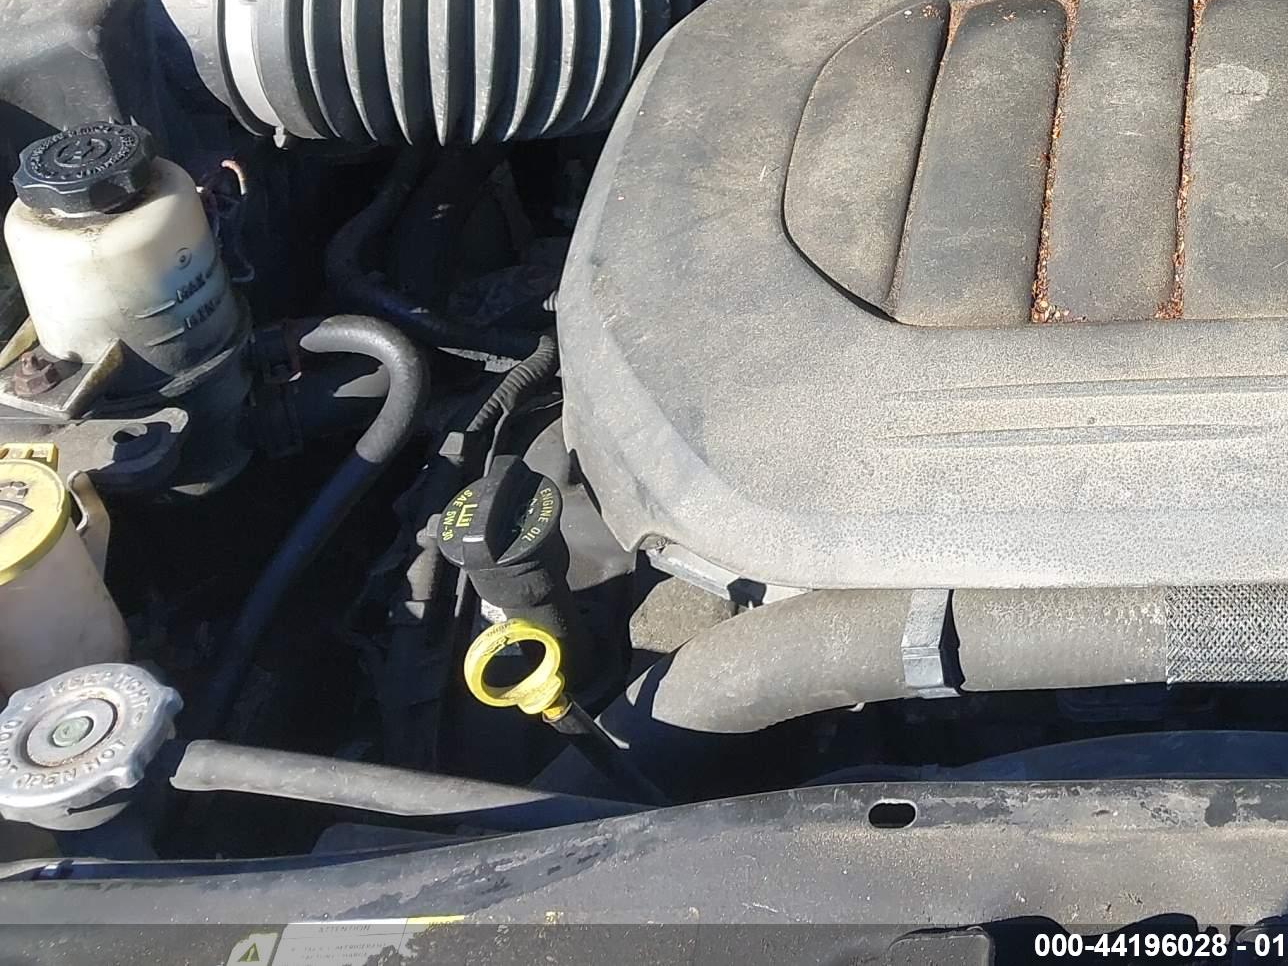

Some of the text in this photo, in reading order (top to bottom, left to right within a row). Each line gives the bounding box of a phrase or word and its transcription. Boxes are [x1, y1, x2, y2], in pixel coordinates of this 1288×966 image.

[441, 489, 473, 542] SAE 5W-30
[521, 487, 554, 542] ENGINE OIL
